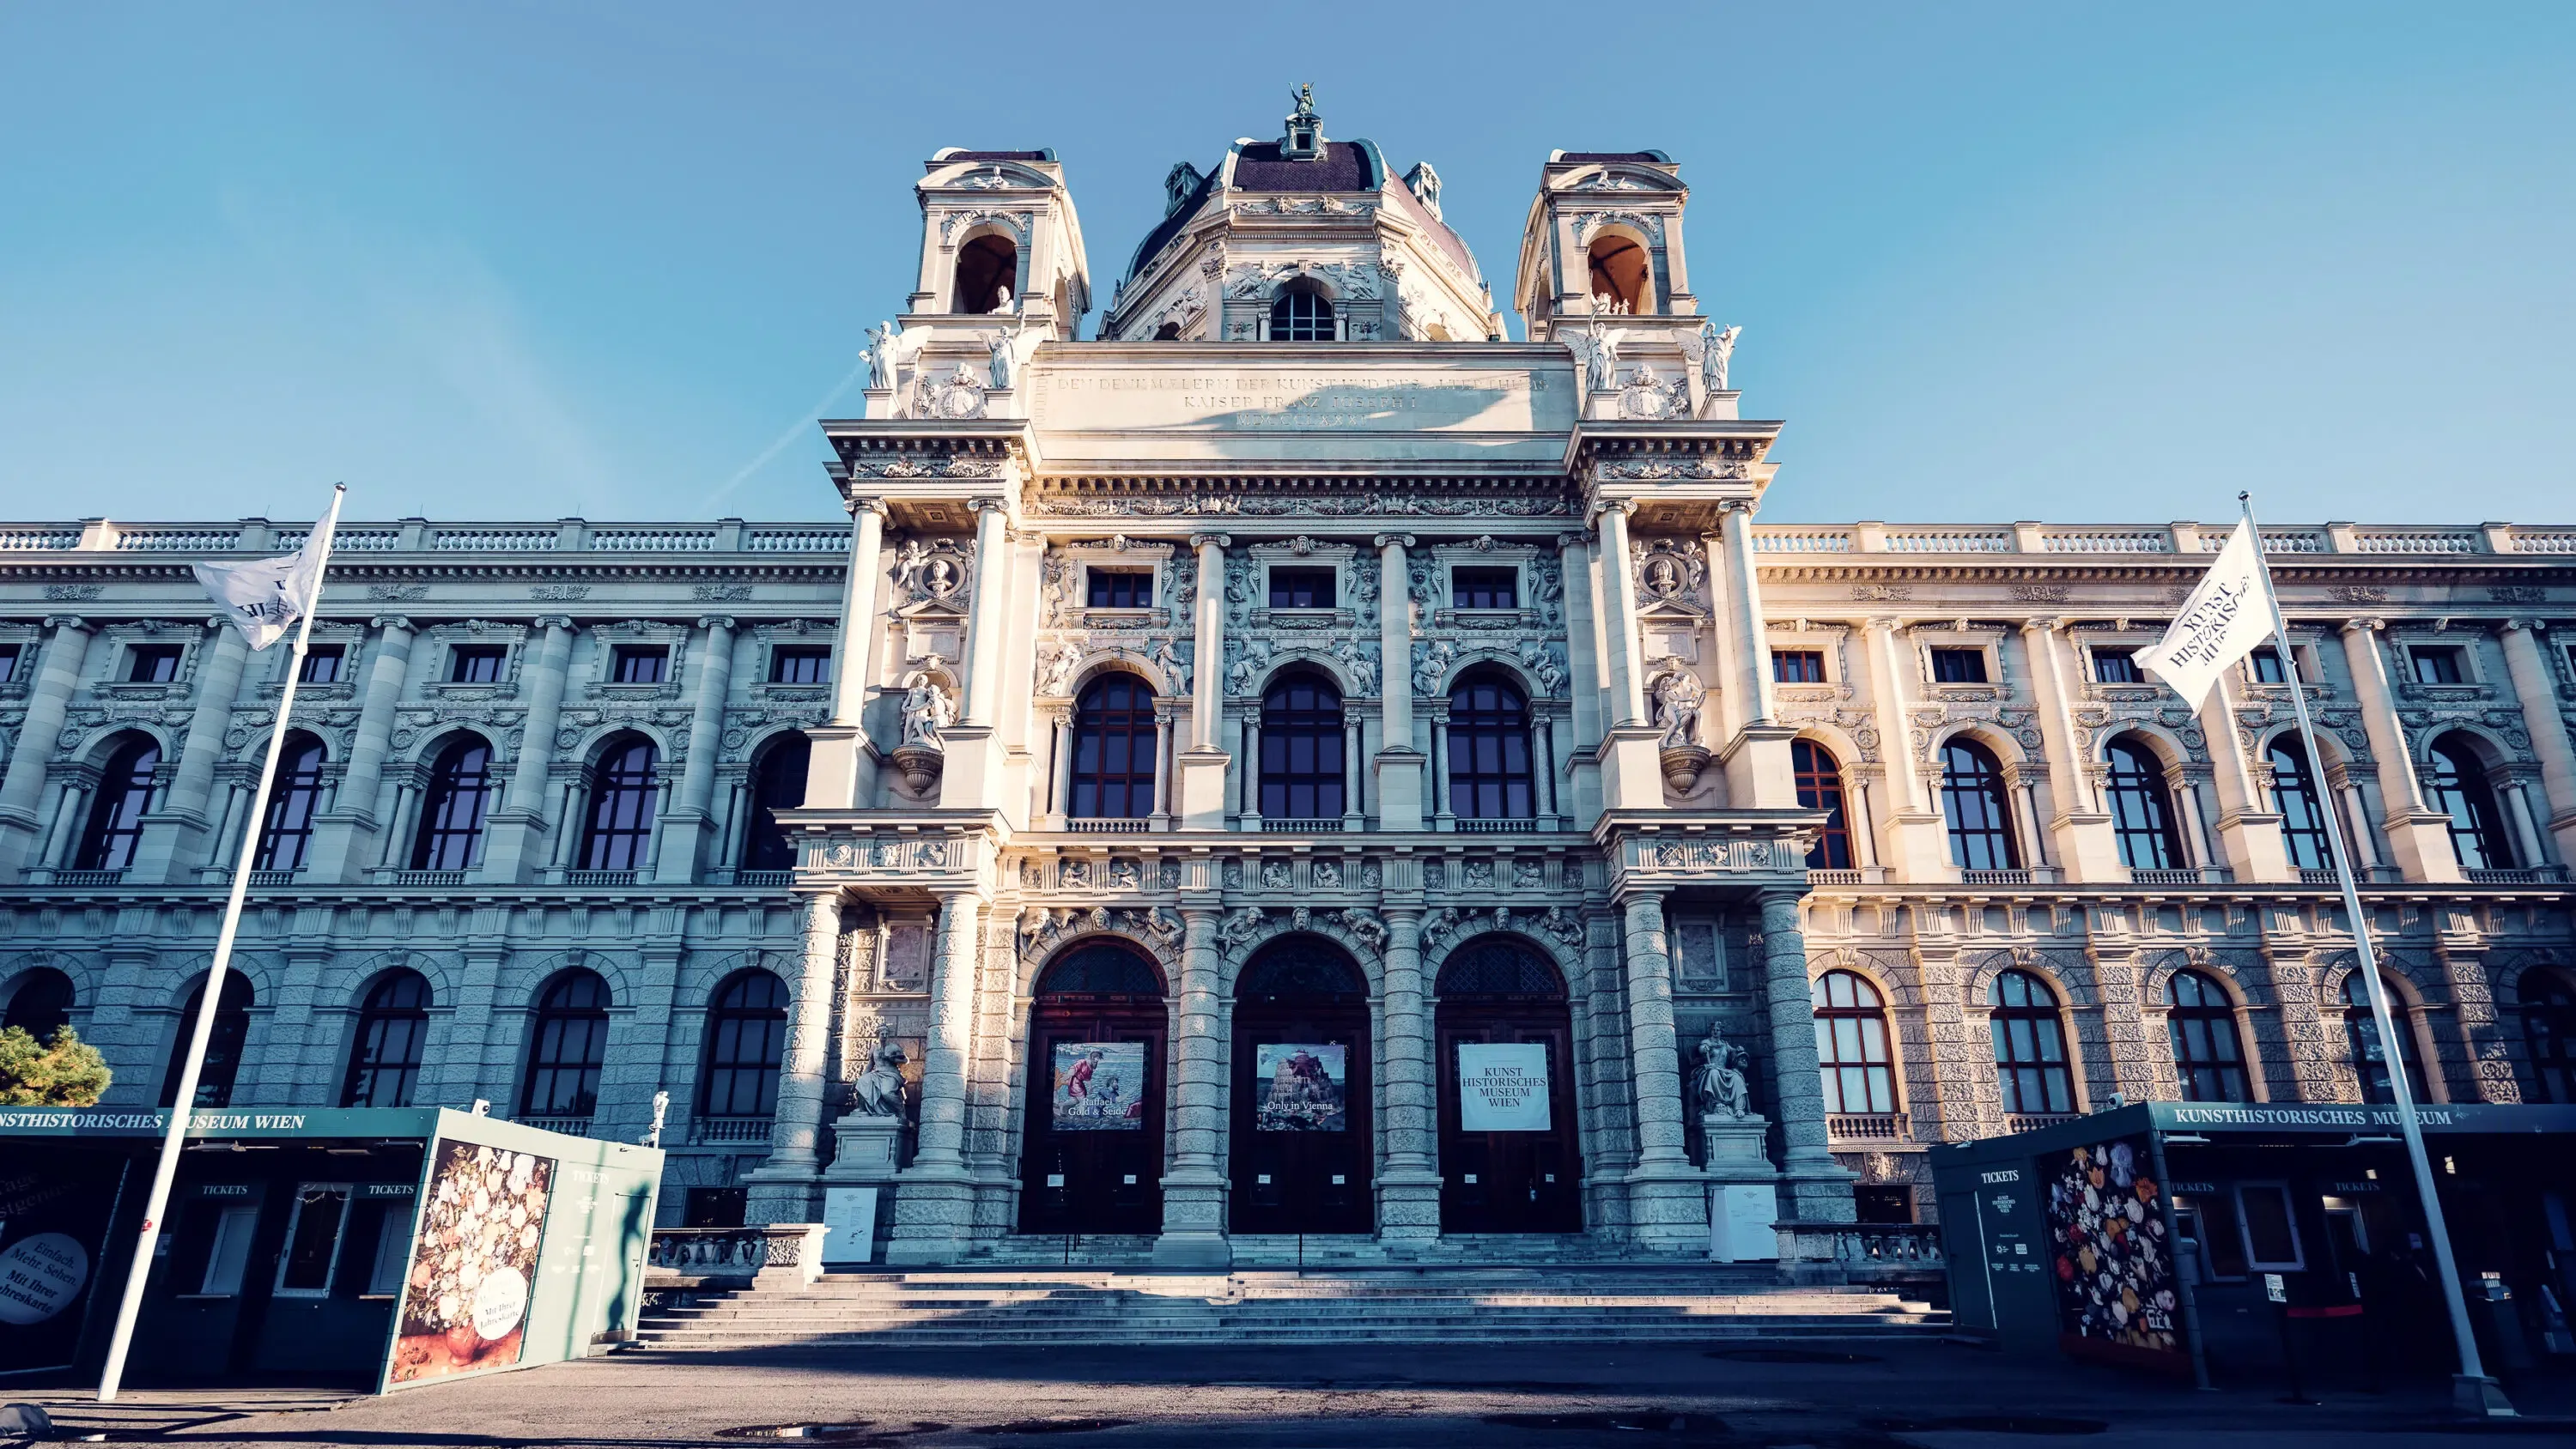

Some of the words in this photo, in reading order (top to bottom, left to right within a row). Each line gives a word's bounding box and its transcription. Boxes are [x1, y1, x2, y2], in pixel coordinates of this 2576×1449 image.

[1057, 378, 1093, 390] DEN
[1236, 378, 1270, 390] DER
[1277, 378, 1336, 391] KUNST
[1184, 397, 1254, 408] KAISER
[1263, 397, 1320, 409] FRANZ
[2183, 582, 2233, 632] KUNST
[1485, 1067, 1523, 1076] KUNST
[1462, 1077, 1546, 1087] HISTORISCHES
[1479, 1088, 1531, 1097] MUSEUM
[1267, 1101, 1289, 1112] Only
[1291, 1101, 1300, 1110] in
[1302, 1101, 1333, 1110] Vienna
[1488, 1098, 1521, 1107] WIEN
[1068, 1106, 1090, 1116] Gold
[2173, 1108, 2366, 1125] KUNSTHISTORISCHES
[2372, 1111, 2453, 1125] MUEUM
[166, 1115, 249, 1130] USEUM
[254, 1114, 307, 1129] WIEN
[573, 1170, 611, 1185] TICKETS
[1981, 1169, 2020, 1184] TICKETS
[202, 1185, 248, 1195] TICKETS
[368, 1185, 415, 1195] TICKETS
[2334, 1182, 2380, 1191] TICKETS
[34, 1241, 75, 1269] Einfach.
[10, 1247, 42, 1270] Mehr.
[43, 1264, 76, 1287] Sehen.
[6, 1270, 29, 1286] Mit
[27, 1279, 58, 1299] Ihrer
